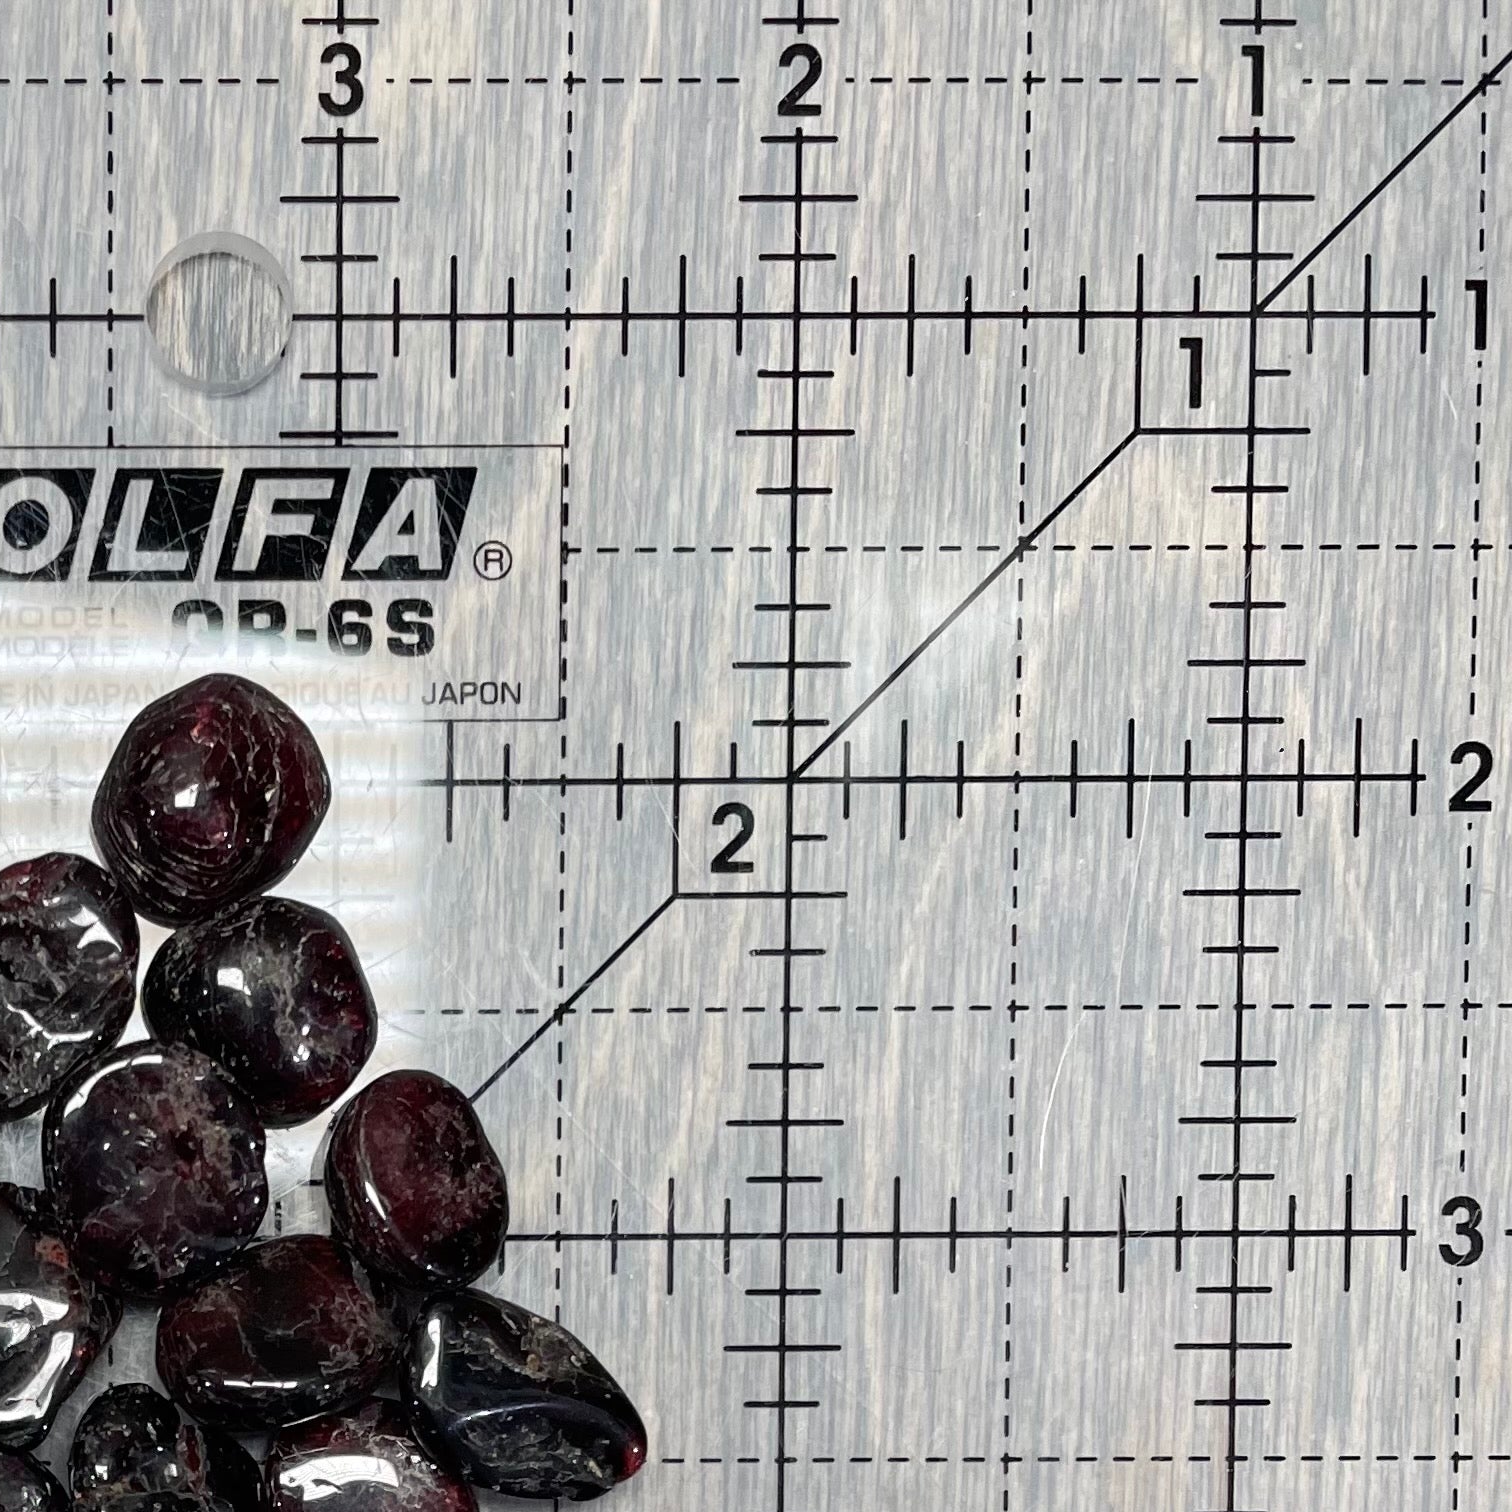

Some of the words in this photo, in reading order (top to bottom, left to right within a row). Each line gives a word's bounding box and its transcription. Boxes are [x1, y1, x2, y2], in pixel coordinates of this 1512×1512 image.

[319, 42, 364, 117] 3
[778, 43, 822, 116] 2
[1242, 45, 1264, 116] 1
[1465, 280, 1487, 350] 1
[1180, 337, 1202, 408] 1
[421, 681, 522, 706] JAPON
[1449, 741, 1493, 812] 2
[711, 802, 754, 873] 2
[1439, 1196, 1483, 1267] 3
